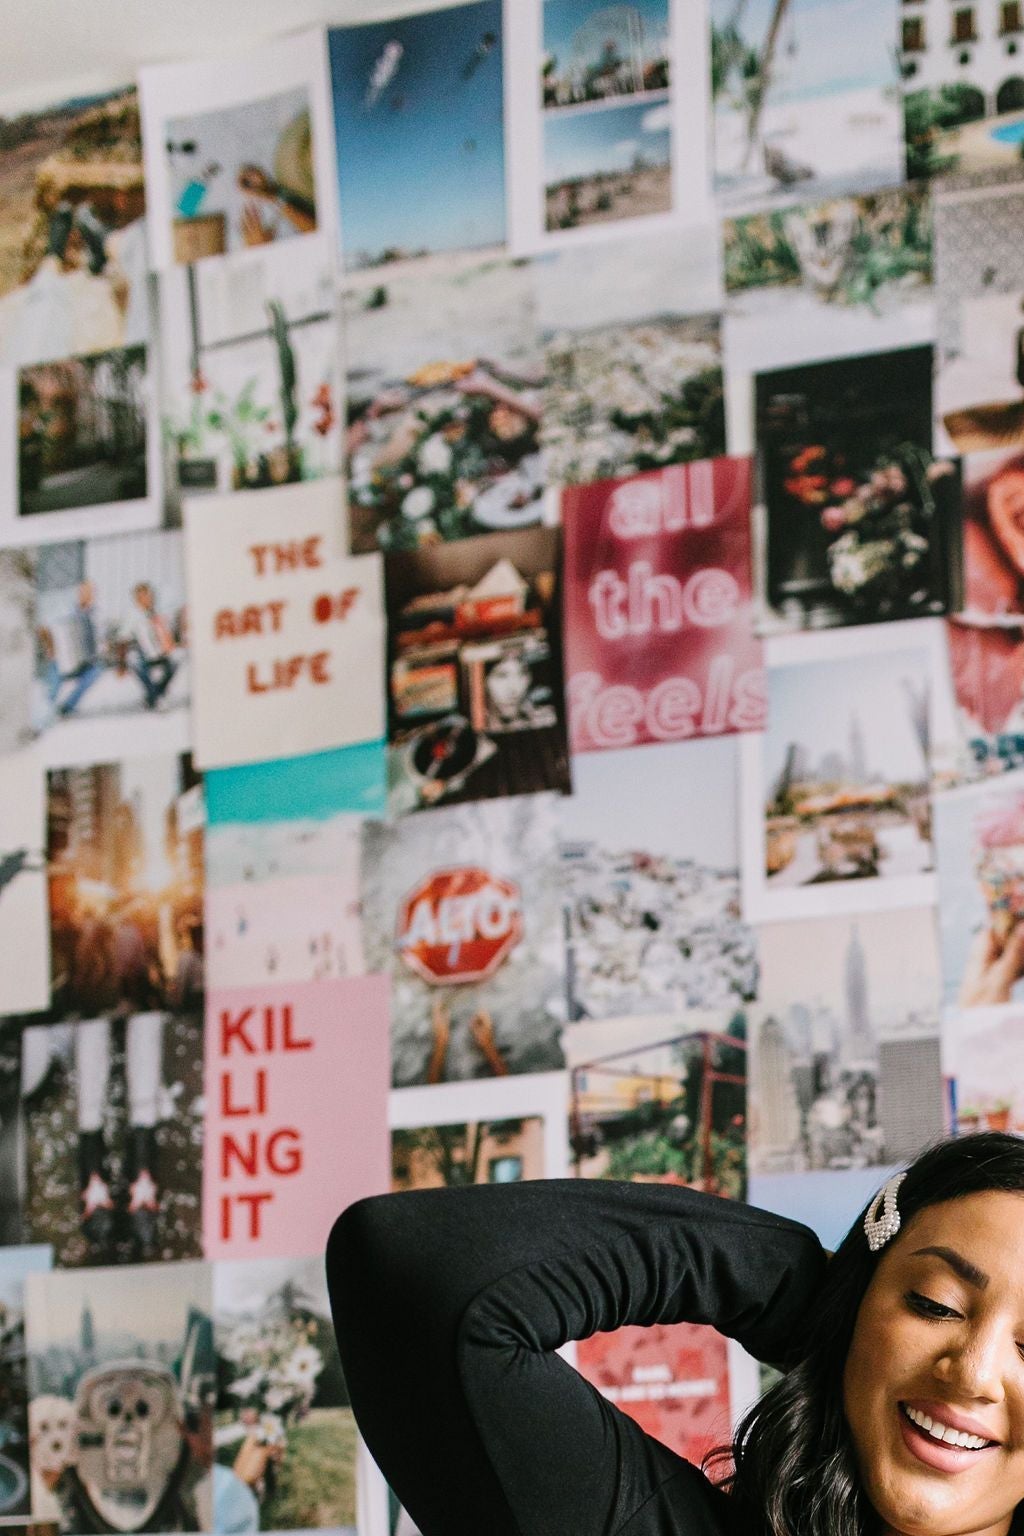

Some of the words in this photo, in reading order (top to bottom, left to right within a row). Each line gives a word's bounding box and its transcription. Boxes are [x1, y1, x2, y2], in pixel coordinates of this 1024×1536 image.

[608, 461, 715, 540] all
[249, 535, 324, 577] THE
[213, 600, 287, 640] ART
[313, 585, 361, 625] OF
[588, 560, 740, 640] the
[246, 651, 332, 694] LIFE
[566, 655, 770, 747] feels
[221, 1004, 315, 1056] KIL
[221, 1069, 266, 1118] LI
[221, 1127, 304, 1180] NG
[221, 1191, 275, 1241] IT
